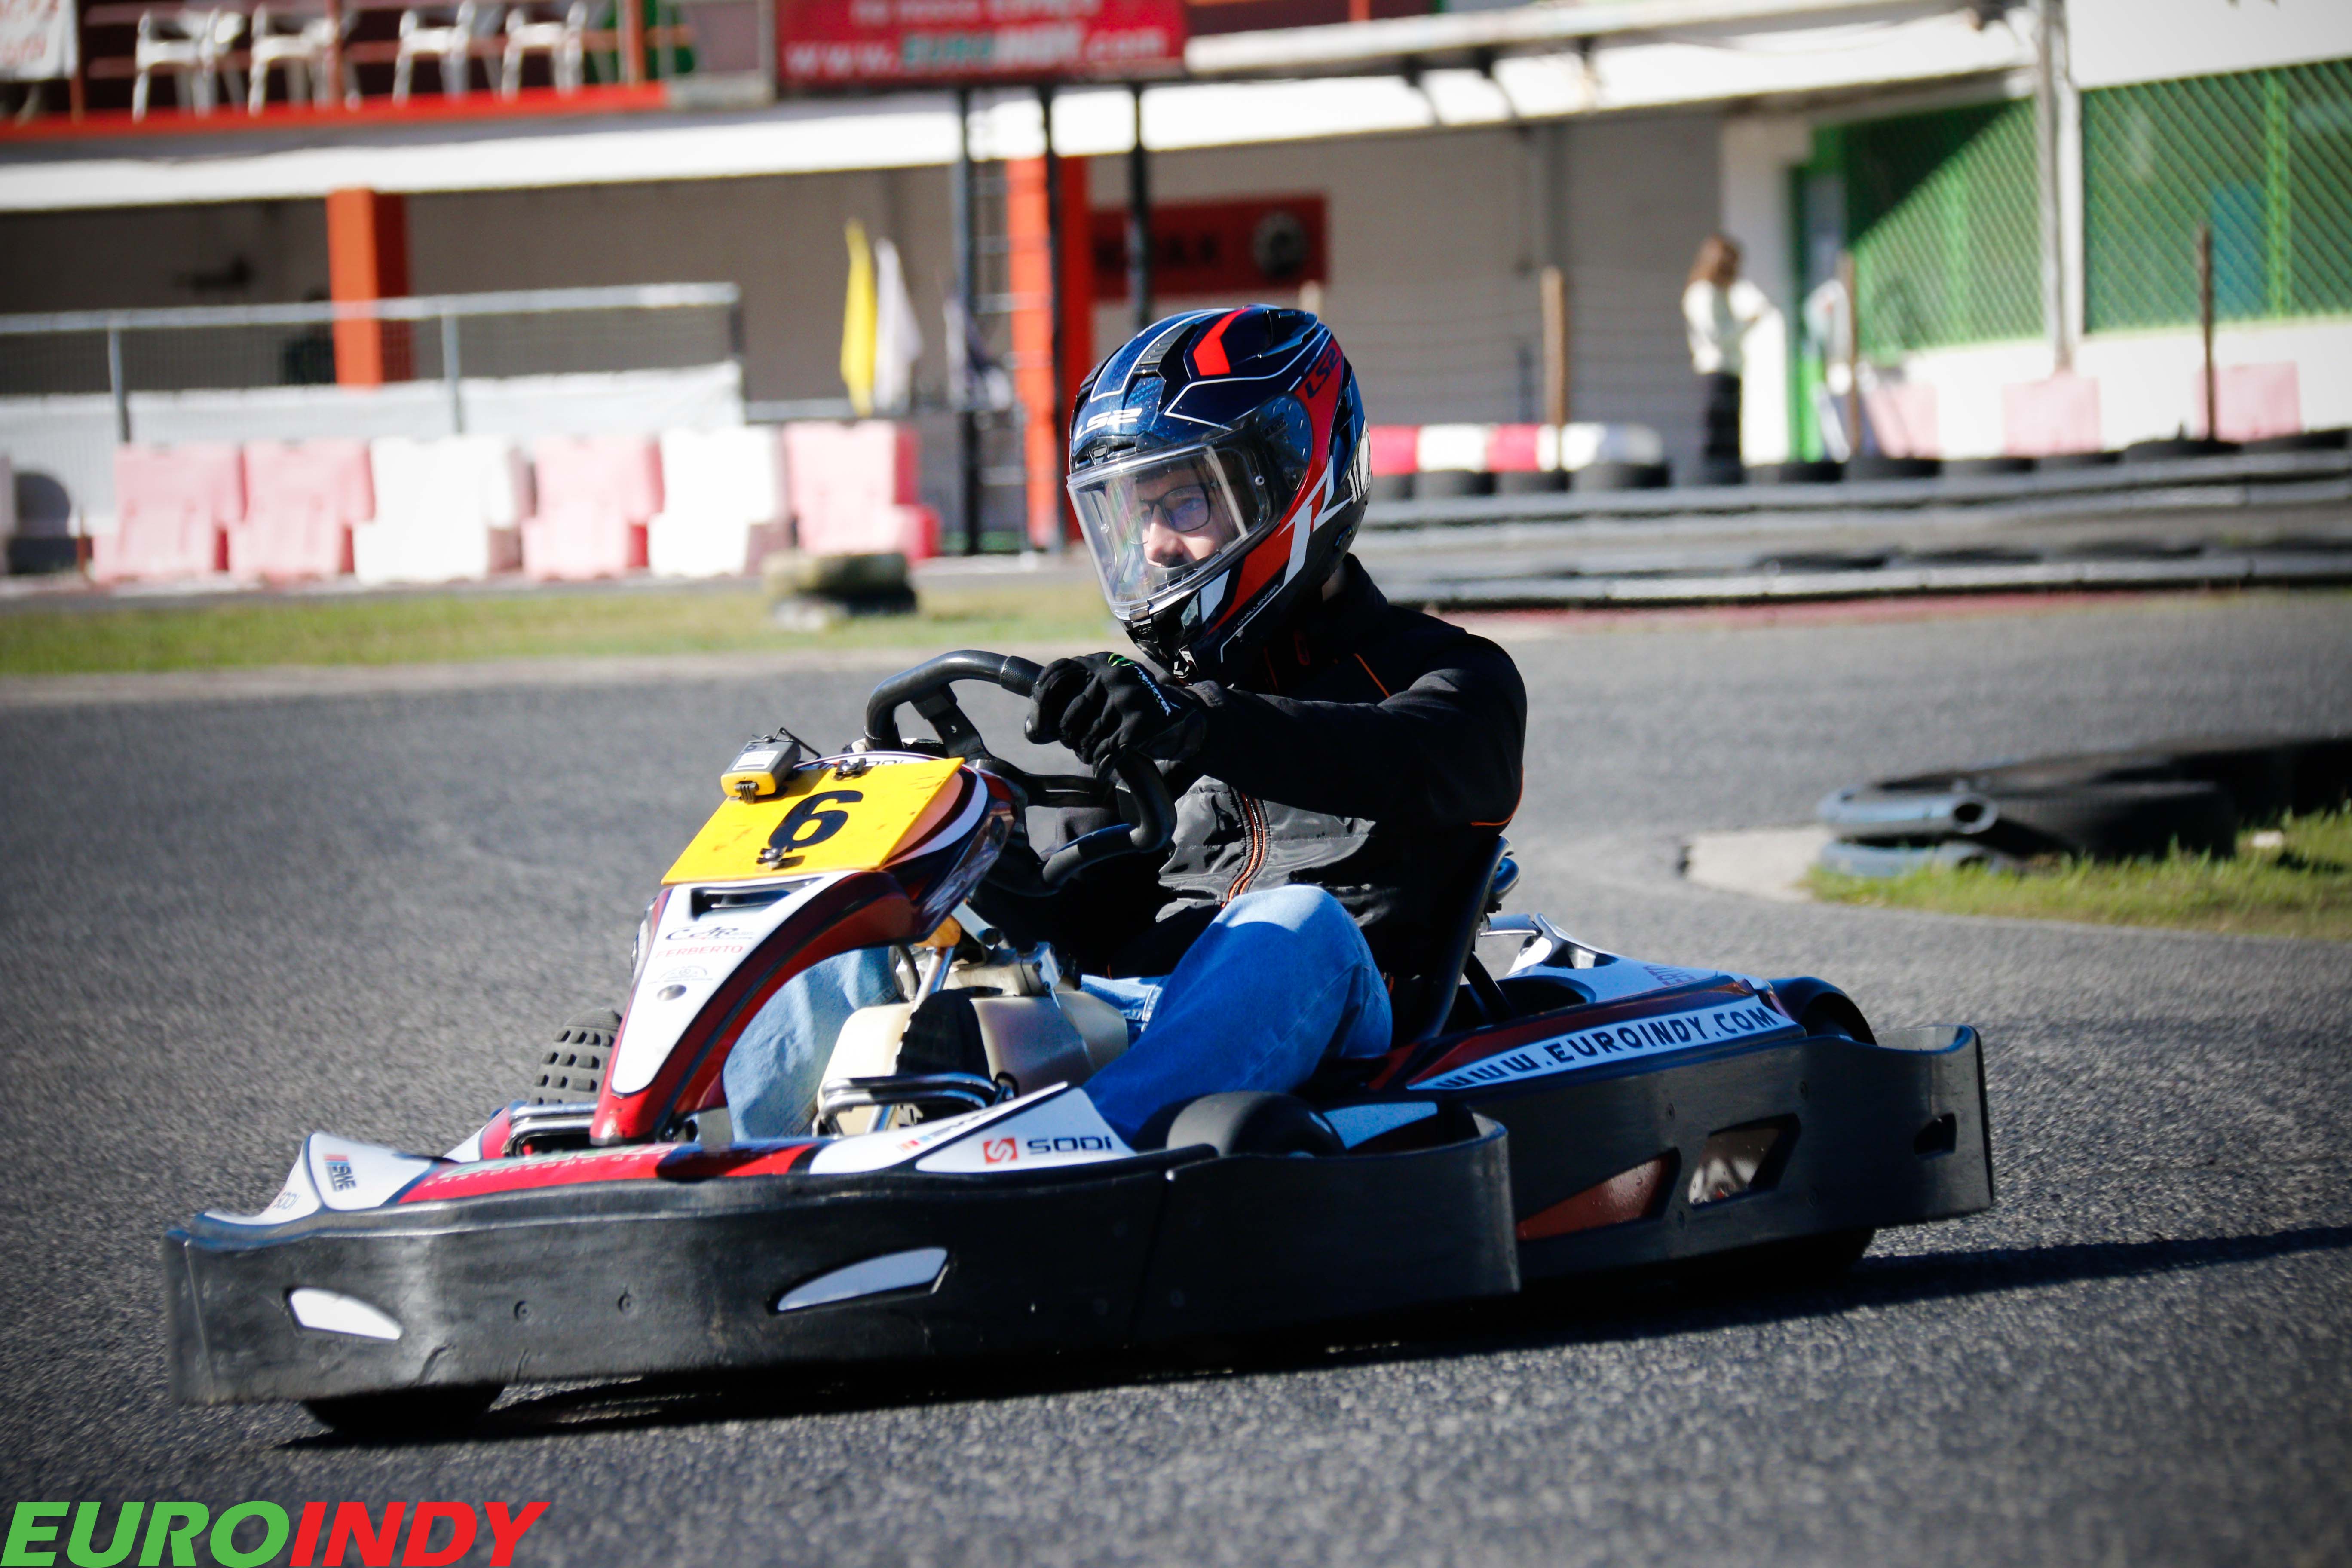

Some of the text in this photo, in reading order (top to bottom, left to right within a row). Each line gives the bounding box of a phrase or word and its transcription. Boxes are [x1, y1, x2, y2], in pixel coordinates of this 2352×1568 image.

[1305, 347, 1339, 398] LS2
[1074, 408, 1143, 442] LS2
[1237, 583, 1280, 626] CHALLENGER
[768, 790, 864, 853] 6
[655, 944, 744, 959] FERBERTO
[1435, 1007, 1779, 1088] WWW.EUROINDY.COM
[1027, 1135, 1112, 1155] SODI
